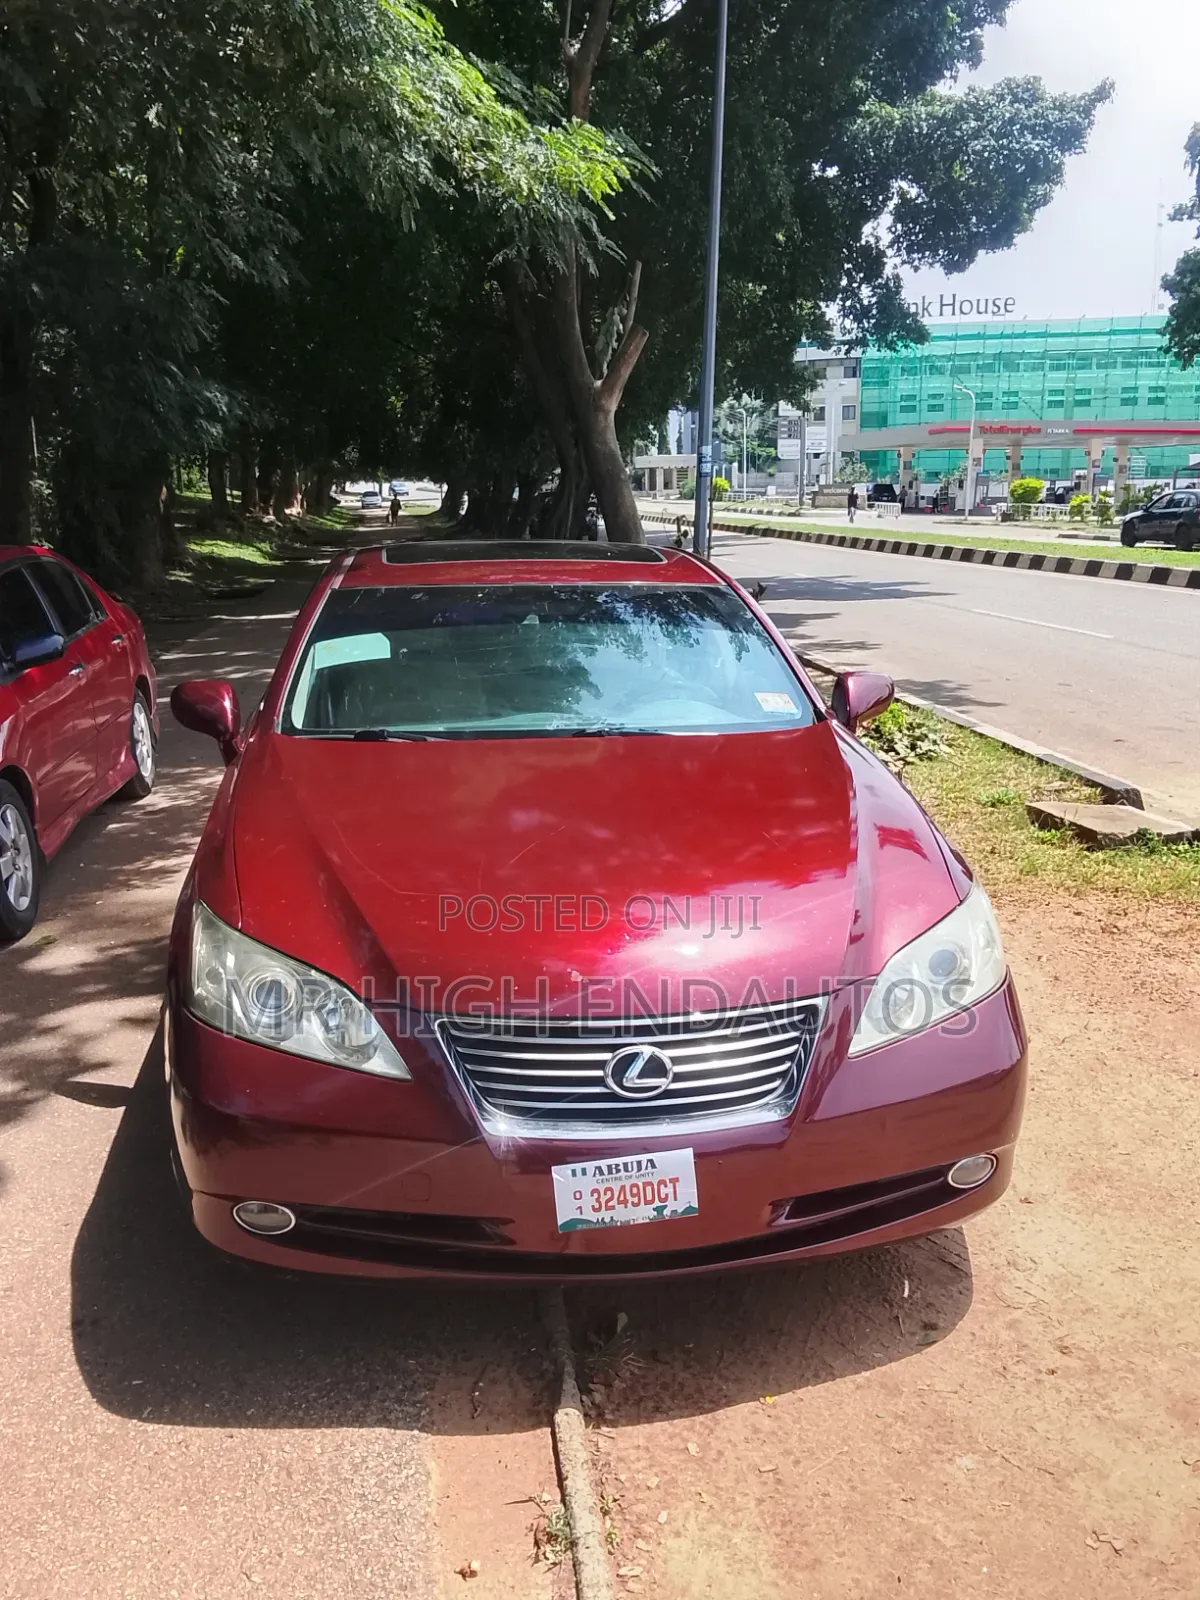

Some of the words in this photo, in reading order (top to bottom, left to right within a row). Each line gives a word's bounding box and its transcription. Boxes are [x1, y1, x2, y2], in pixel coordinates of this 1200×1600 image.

[906, 295, 934, 318] nk
[939, 293, 1016, 316] House
[592, 1158, 658, 1178] ABUJA
[596, 1176, 623, 1184] CENTRE
[635, 1171, 655, 1179] UNITY
[590, 1177, 680, 1213] 3249DCT
